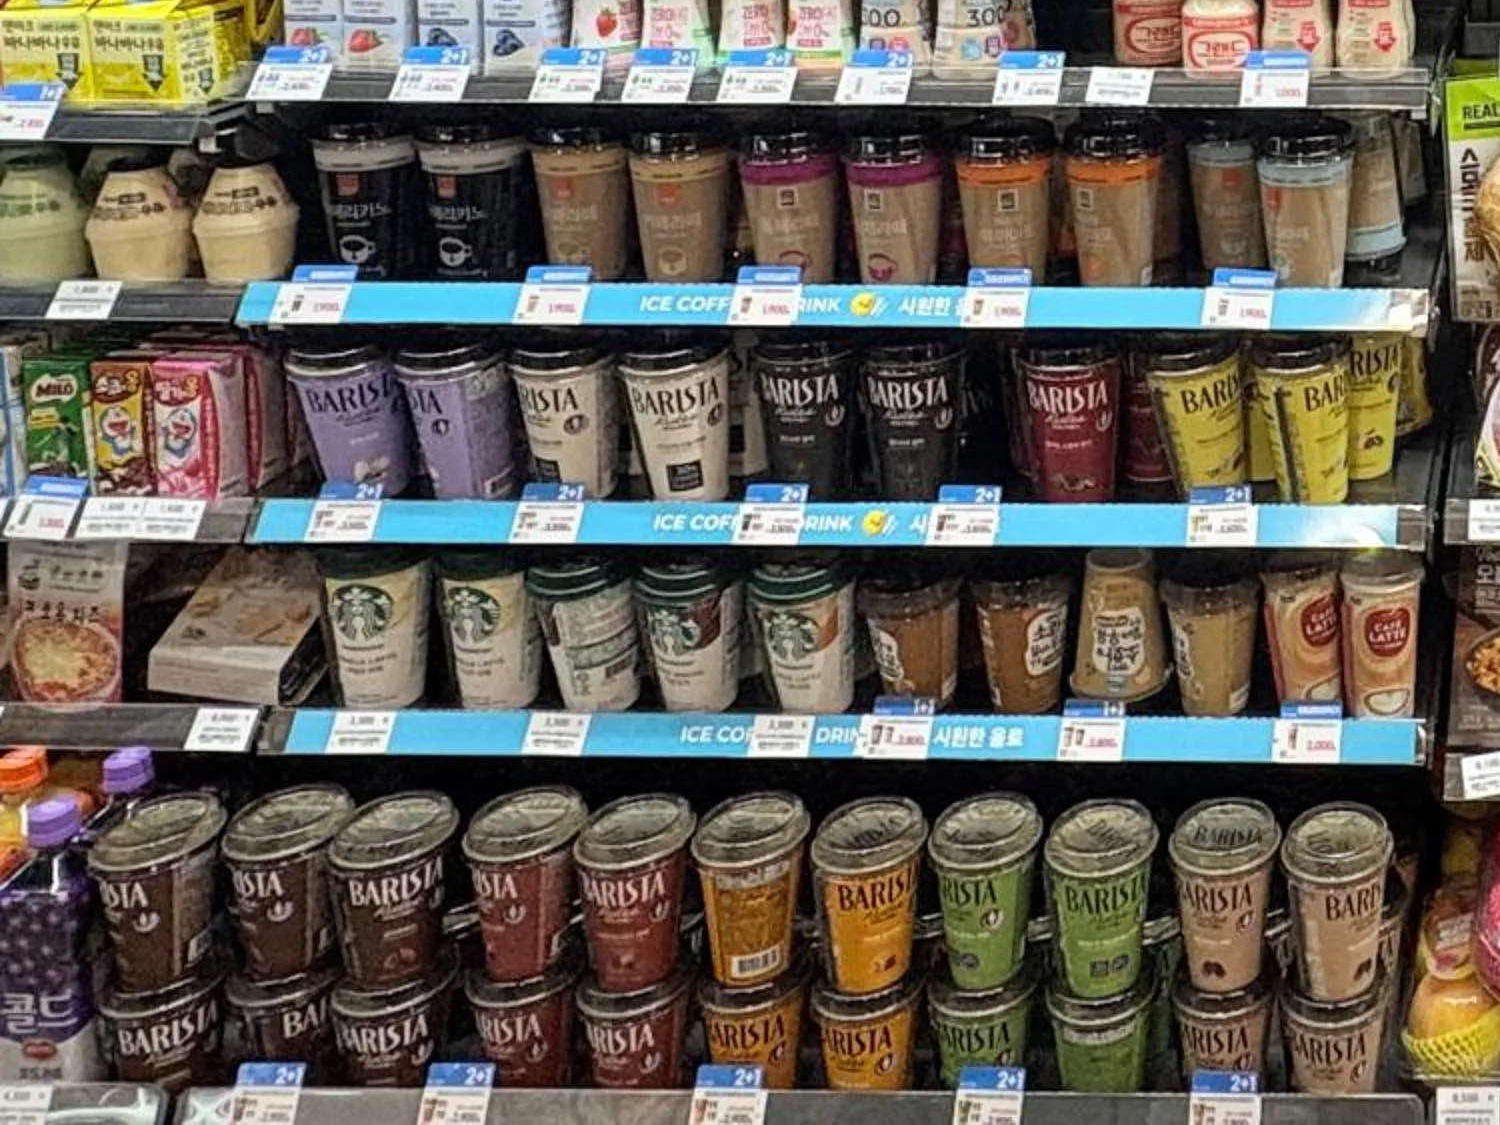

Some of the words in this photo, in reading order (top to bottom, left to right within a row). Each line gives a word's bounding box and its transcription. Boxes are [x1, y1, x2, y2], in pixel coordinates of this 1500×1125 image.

[578, 49, 606, 65] 2+1
[670, 49, 698, 65] 2+1
[639, 296, 674, 312] ICE
[676, 295, 730, 313] COFF
[897, 297, 950, 316] 시원한
[35, 382, 75, 397] MILO
[633, 379, 719, 416] BARISTA
[1027, 378, 1109, 414] BARISTA
[521, 386, 578, 414] RISTA
[354, 484, 382, 499] 2+1
[556, 485, 584, 501] 2+1
[780, 486, 808, 502] 2+1
[975, 486, 1002, 503] 2+1
[1225, 486, 1252, 503] 2+1
[653, 513, 684, 531] ICE
[1368, 630, 1408, 645] LATTE
[680, 725, 713, 743] ICE
[932, 725, 984, 748] 시원한
[943, 878, 998, 906] RISTA
[1, 992, 74, 1033] 콜드
[1181, 1024, 1251, 1055] ARISTA
[274, 1065, 304, 1086] 2+1
[463, 1065, 494, 1086] 2+1
[734, 1069, 763, 1087] 2+1
[996, 1069, 1025, 1089] 2+1
[1229, 1074, 1258, 1092] 2+1
